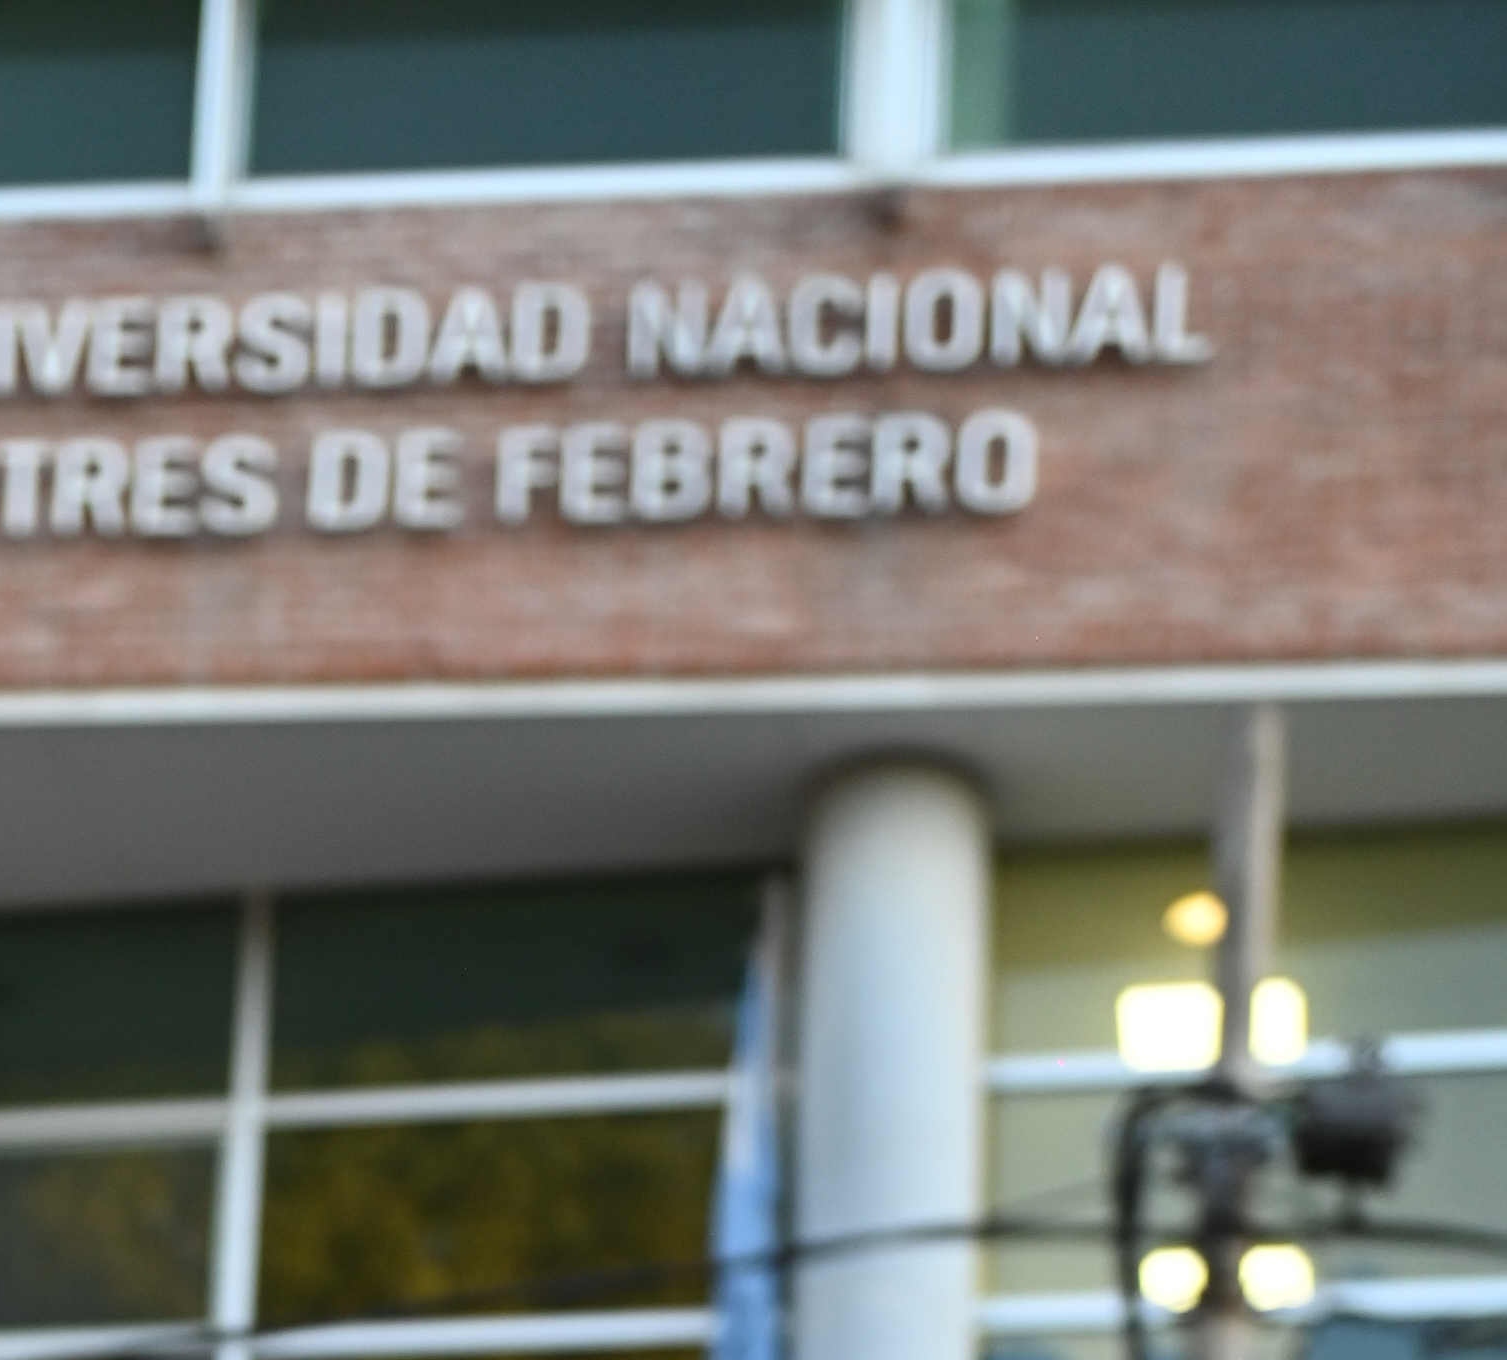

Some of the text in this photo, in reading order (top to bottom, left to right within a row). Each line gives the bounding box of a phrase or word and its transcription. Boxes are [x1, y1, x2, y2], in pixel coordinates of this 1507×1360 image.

[628, 262, 1214, 379] NACIONAL
[306, 429, 463, 531] DE
[496, 410, 1037, 522] FEBRERO
